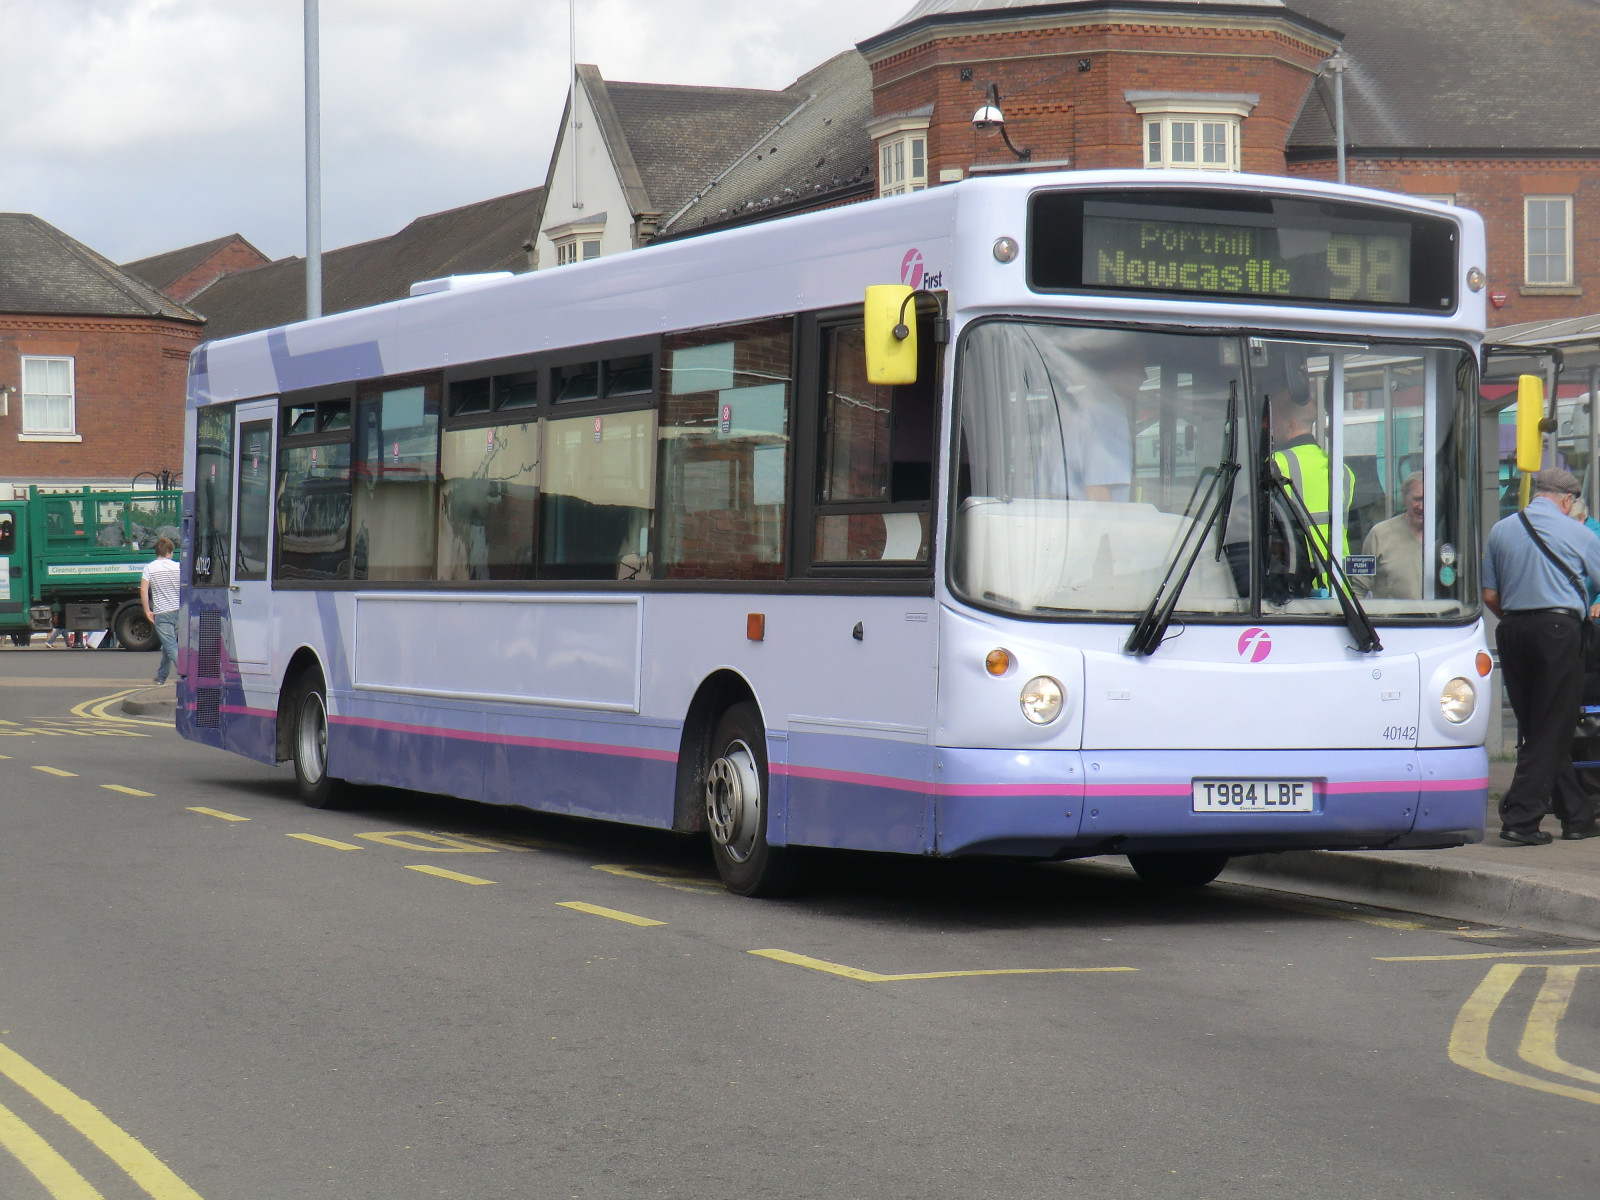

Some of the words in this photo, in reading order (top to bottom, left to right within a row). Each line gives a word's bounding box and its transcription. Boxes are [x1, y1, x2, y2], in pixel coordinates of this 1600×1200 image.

[1141, 223, 1250, 255] Porthill
[1098, 249, 1290, 294] Newcastle
[1327, 235, 1400, 301] 98
[923, 270, 943, 290] First
[104, 565, 120, 573] safer
[1382, 726, 1417, 740] 40142
[1202, 783, 1258, 806] T984
[1264, 783, 1304, 806] LBF
